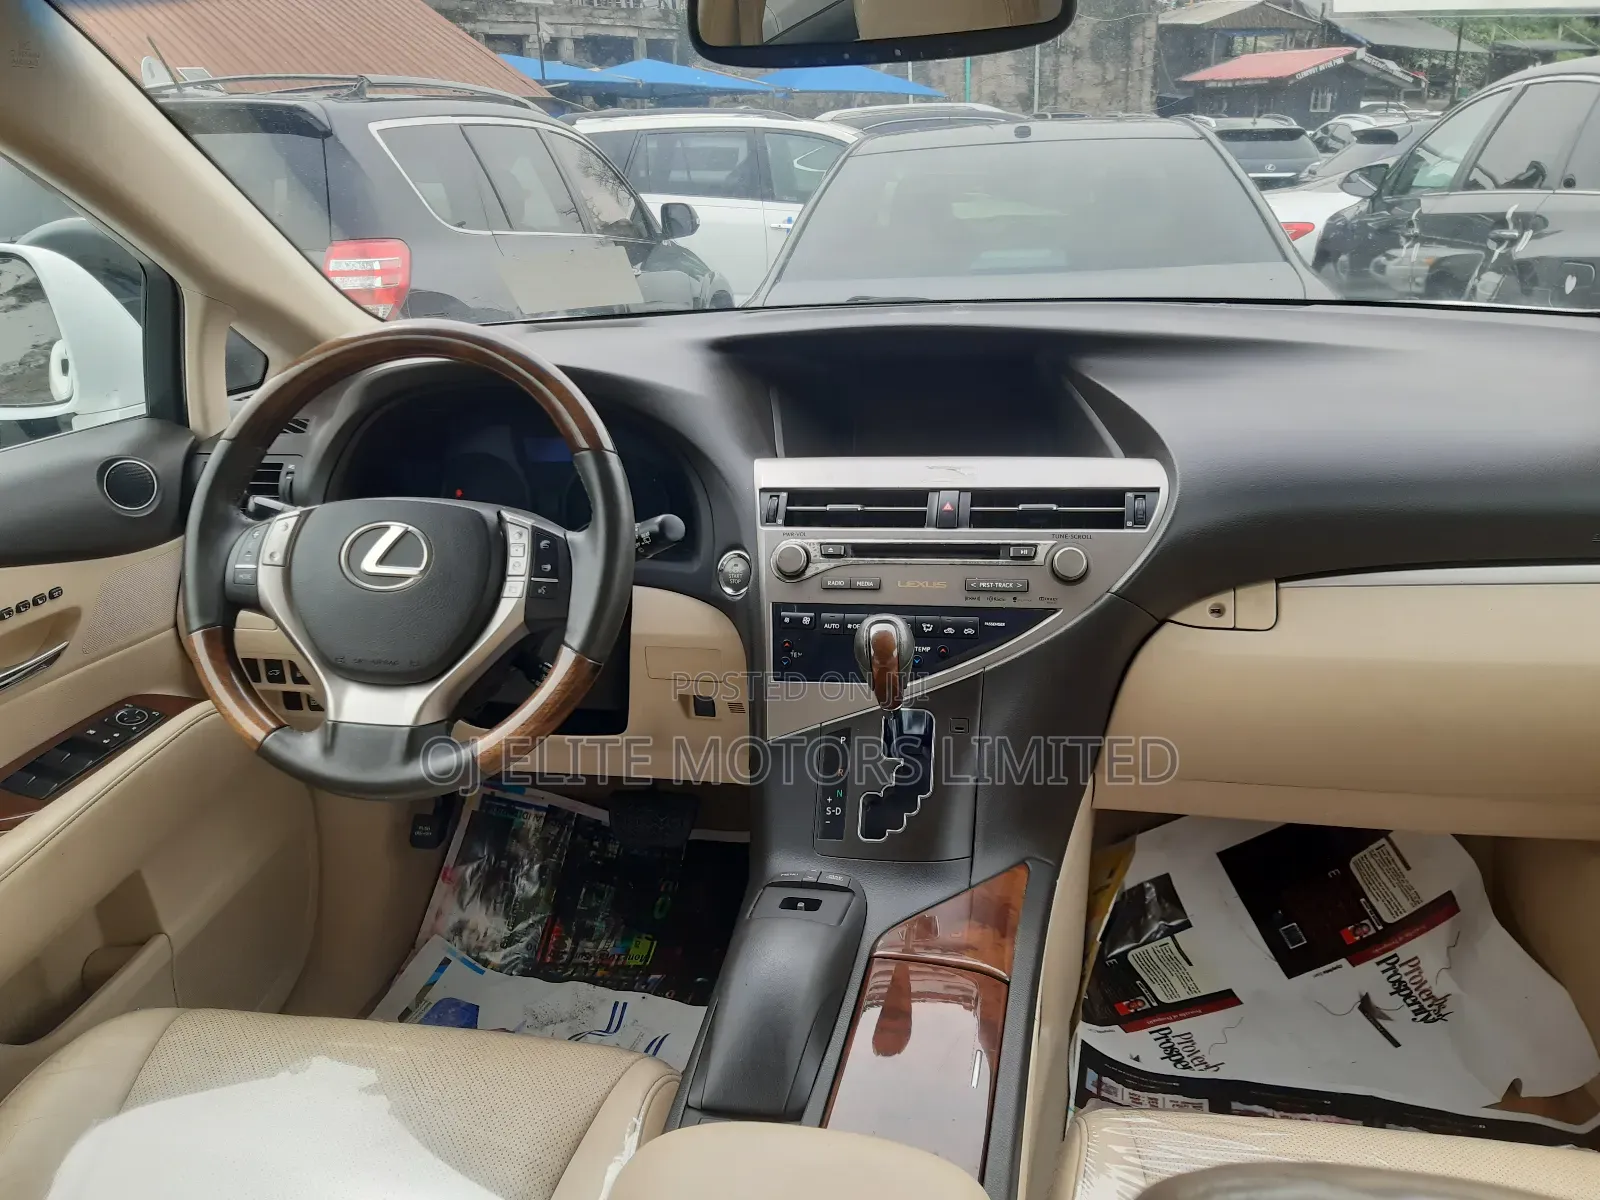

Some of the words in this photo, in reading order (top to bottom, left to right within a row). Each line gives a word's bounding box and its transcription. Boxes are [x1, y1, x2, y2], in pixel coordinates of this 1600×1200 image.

[897, 580, 947, 589] LEXUS
[979, 581, 1014, 589] PRST-TRACK
[840, 736, 847, 745] P
[837, 768, 844, 776] R
[836, 789, 843, 797] N
[826, 806, 842, 815] S-D
